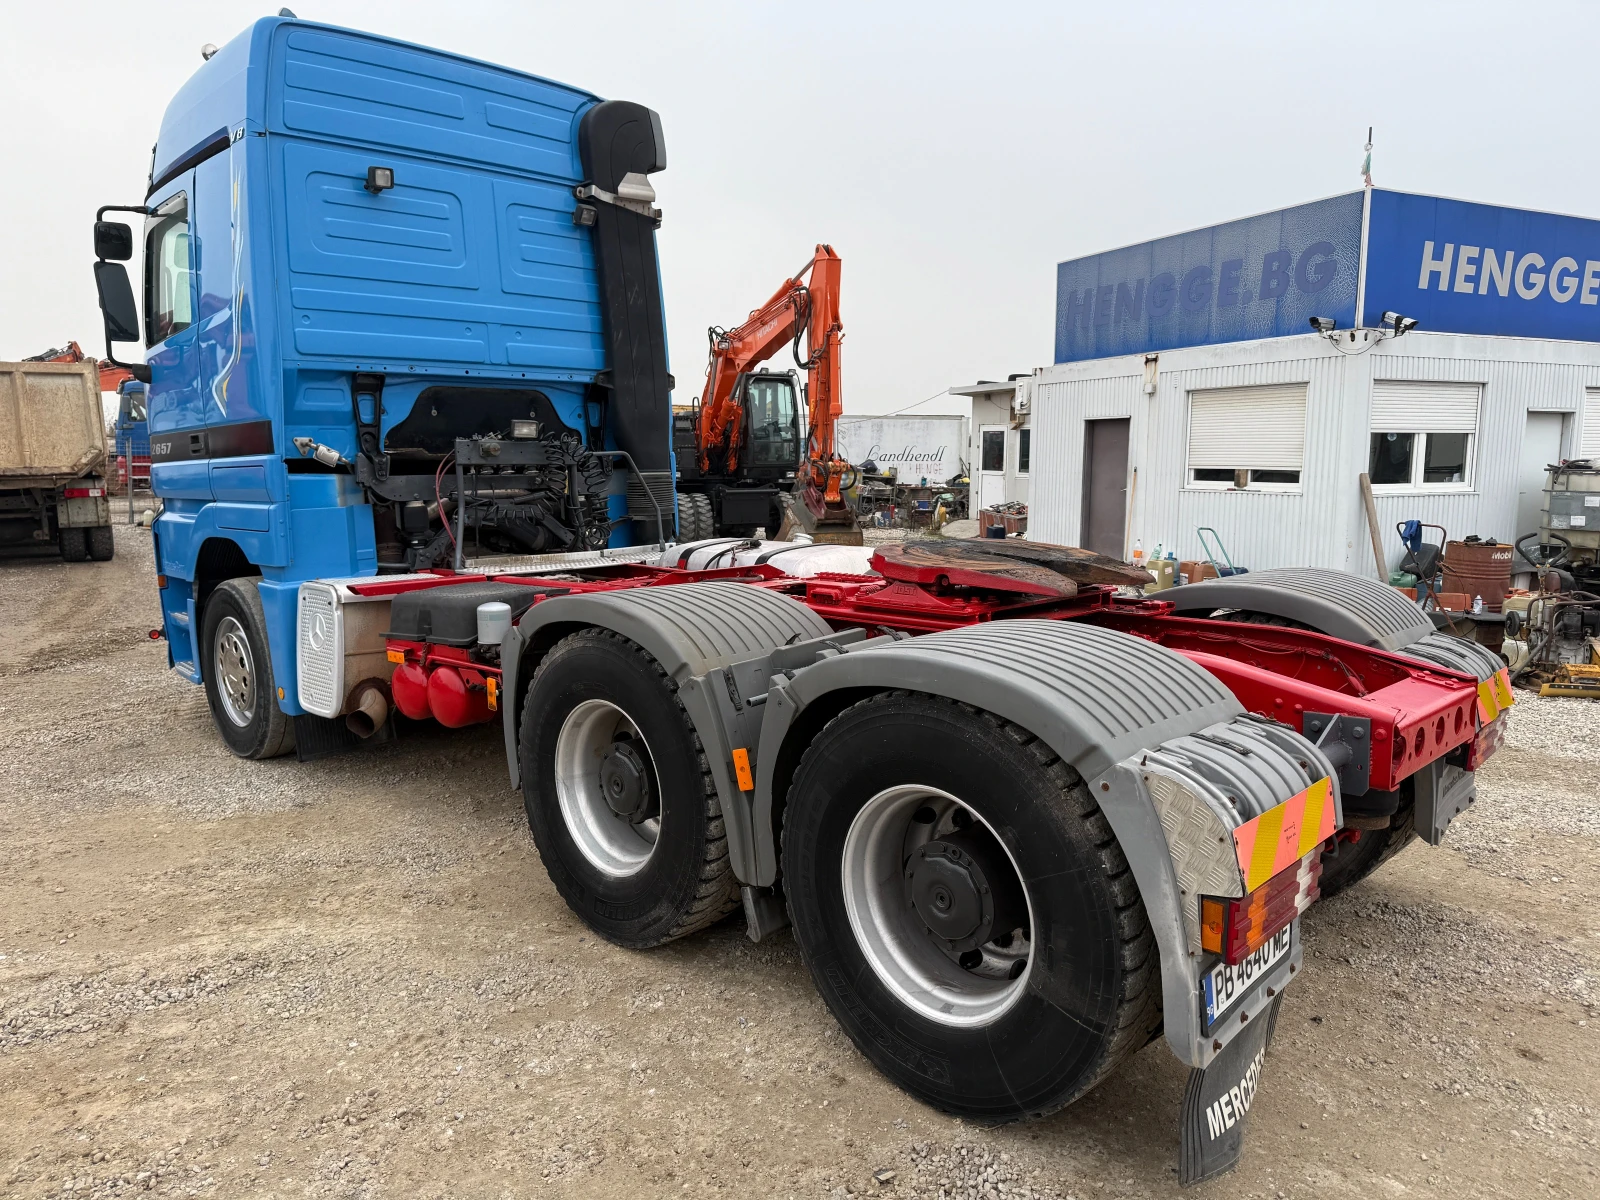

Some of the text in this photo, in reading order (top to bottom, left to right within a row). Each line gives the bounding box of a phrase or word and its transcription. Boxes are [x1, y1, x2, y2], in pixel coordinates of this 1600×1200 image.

[230, 126, 244, 144] V8
[1065, 241, 1338, 331] HENGGE.BG
[1418, 240, 1600, 305] HENGGE
[152, 442, 171, 455] 2657
[866, 444, 947, 462] Landhendl
[1214, 964, 1234, 1011] PB
[1237, 939, 1270, 987] 4640
